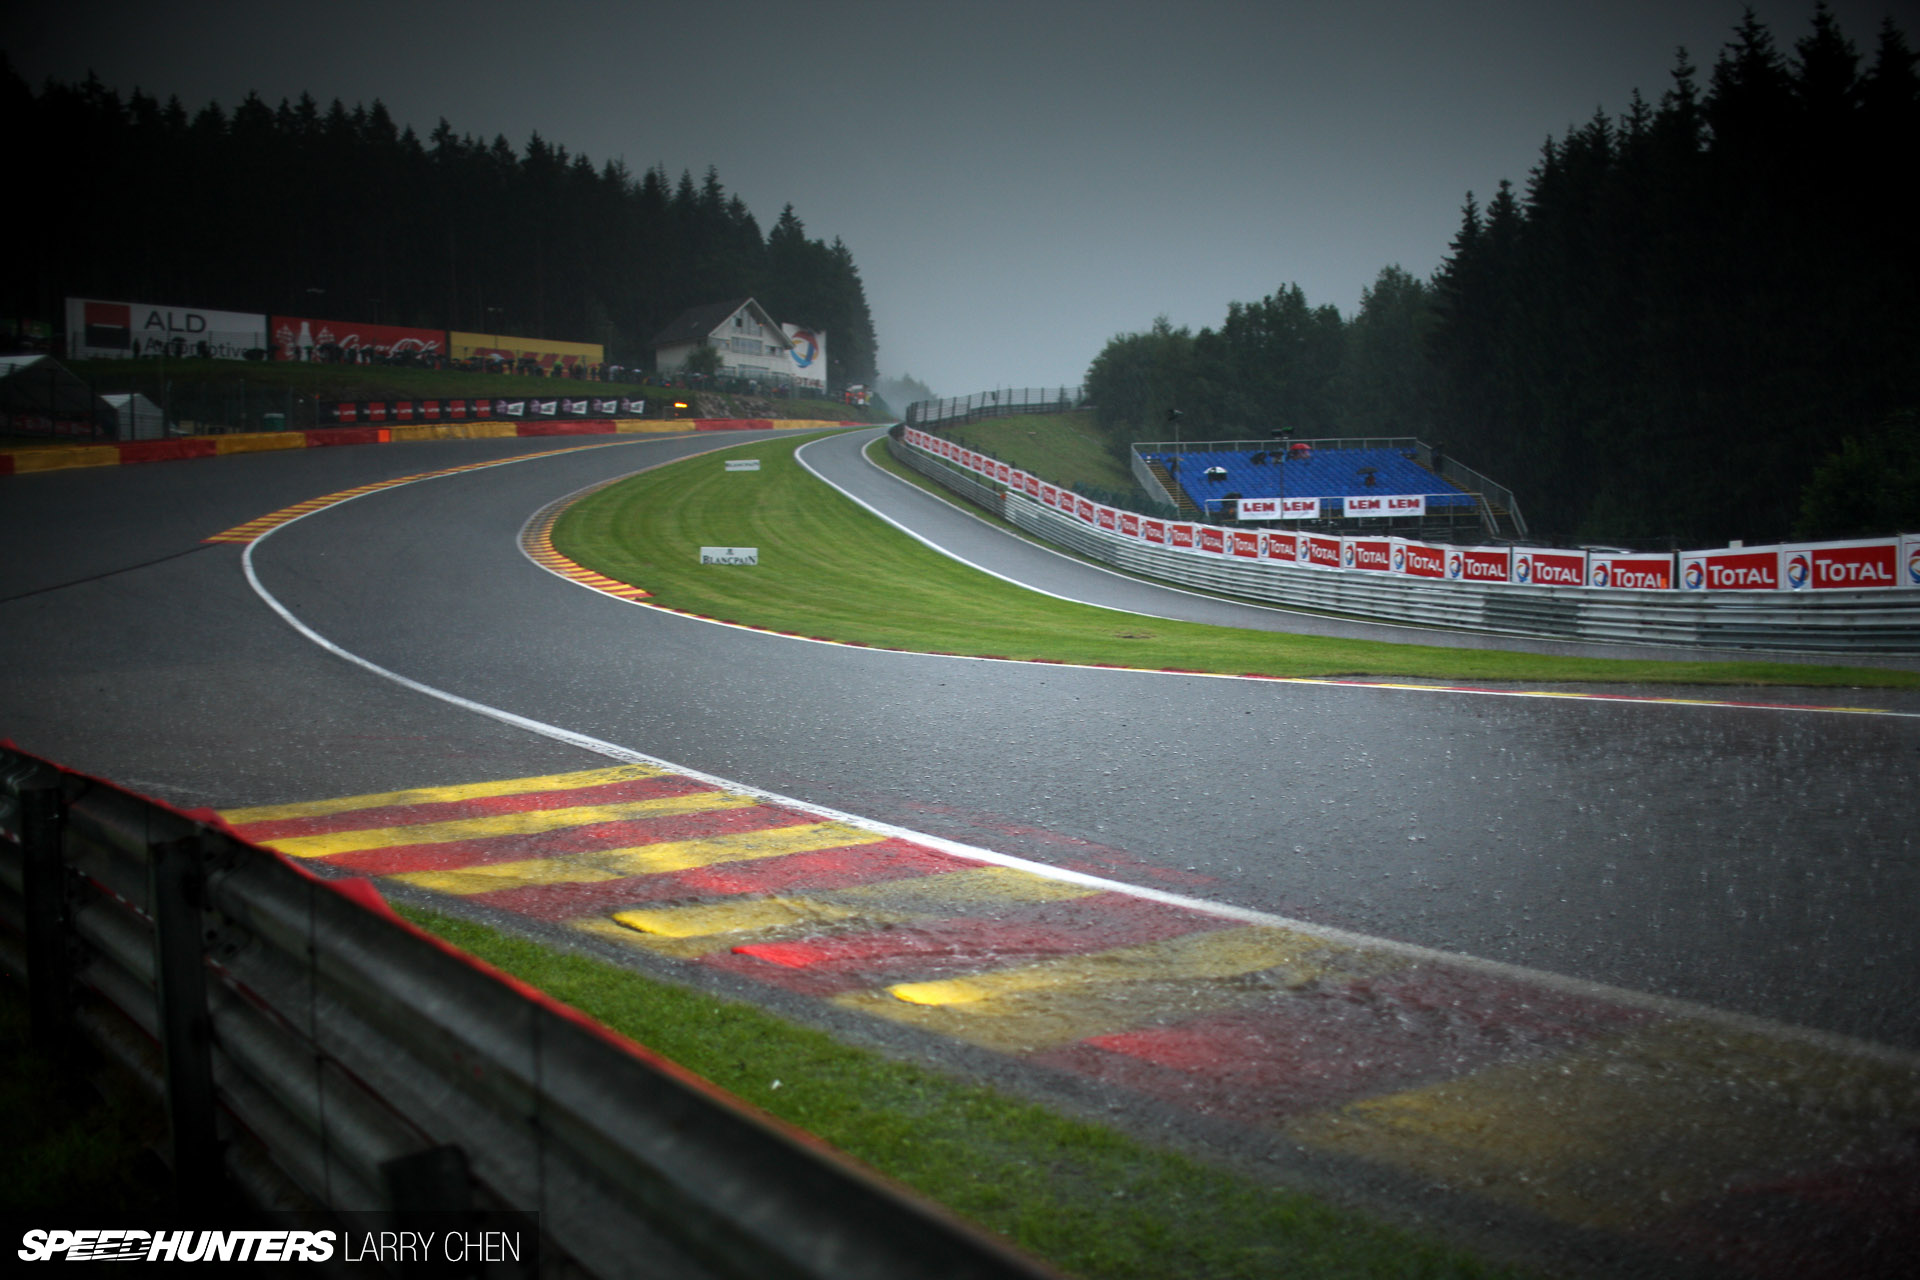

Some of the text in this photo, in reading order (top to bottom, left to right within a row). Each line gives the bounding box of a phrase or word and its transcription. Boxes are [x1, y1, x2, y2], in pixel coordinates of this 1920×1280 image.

[145, 310, 206, 333] ALD
[145, 337, 248, 358] Atomotive
[1243, 502, 1275, 512] LEM
[1282, 501, 1315, 511] LEM
[1348, 500, 1381, 510] LEM
[1388, 499, 1420, 509] LEM
[1173, 528, 1192, 542] TOTAL
[1202, 533, 1223, 549] TOTAL
[1234, 537, 1258, 552] TOTAL
[1270, 539, 1296, 556] TOTAL
[1310, 543, 1340, 561] TOTAL
[703, 555, 759, 565] BLANCPAIN
[1356, 547, 1389, 564] TOTAL
[1407, 552, 1443, 572] TOTAL
[1465, 558, 1506, 577] TOTAL
[1534, 561, 1581, 583] TOTAL
[1709, 564, 1775, 586] TOTAL
[1815, 559, 1893, 581] TOTAL
